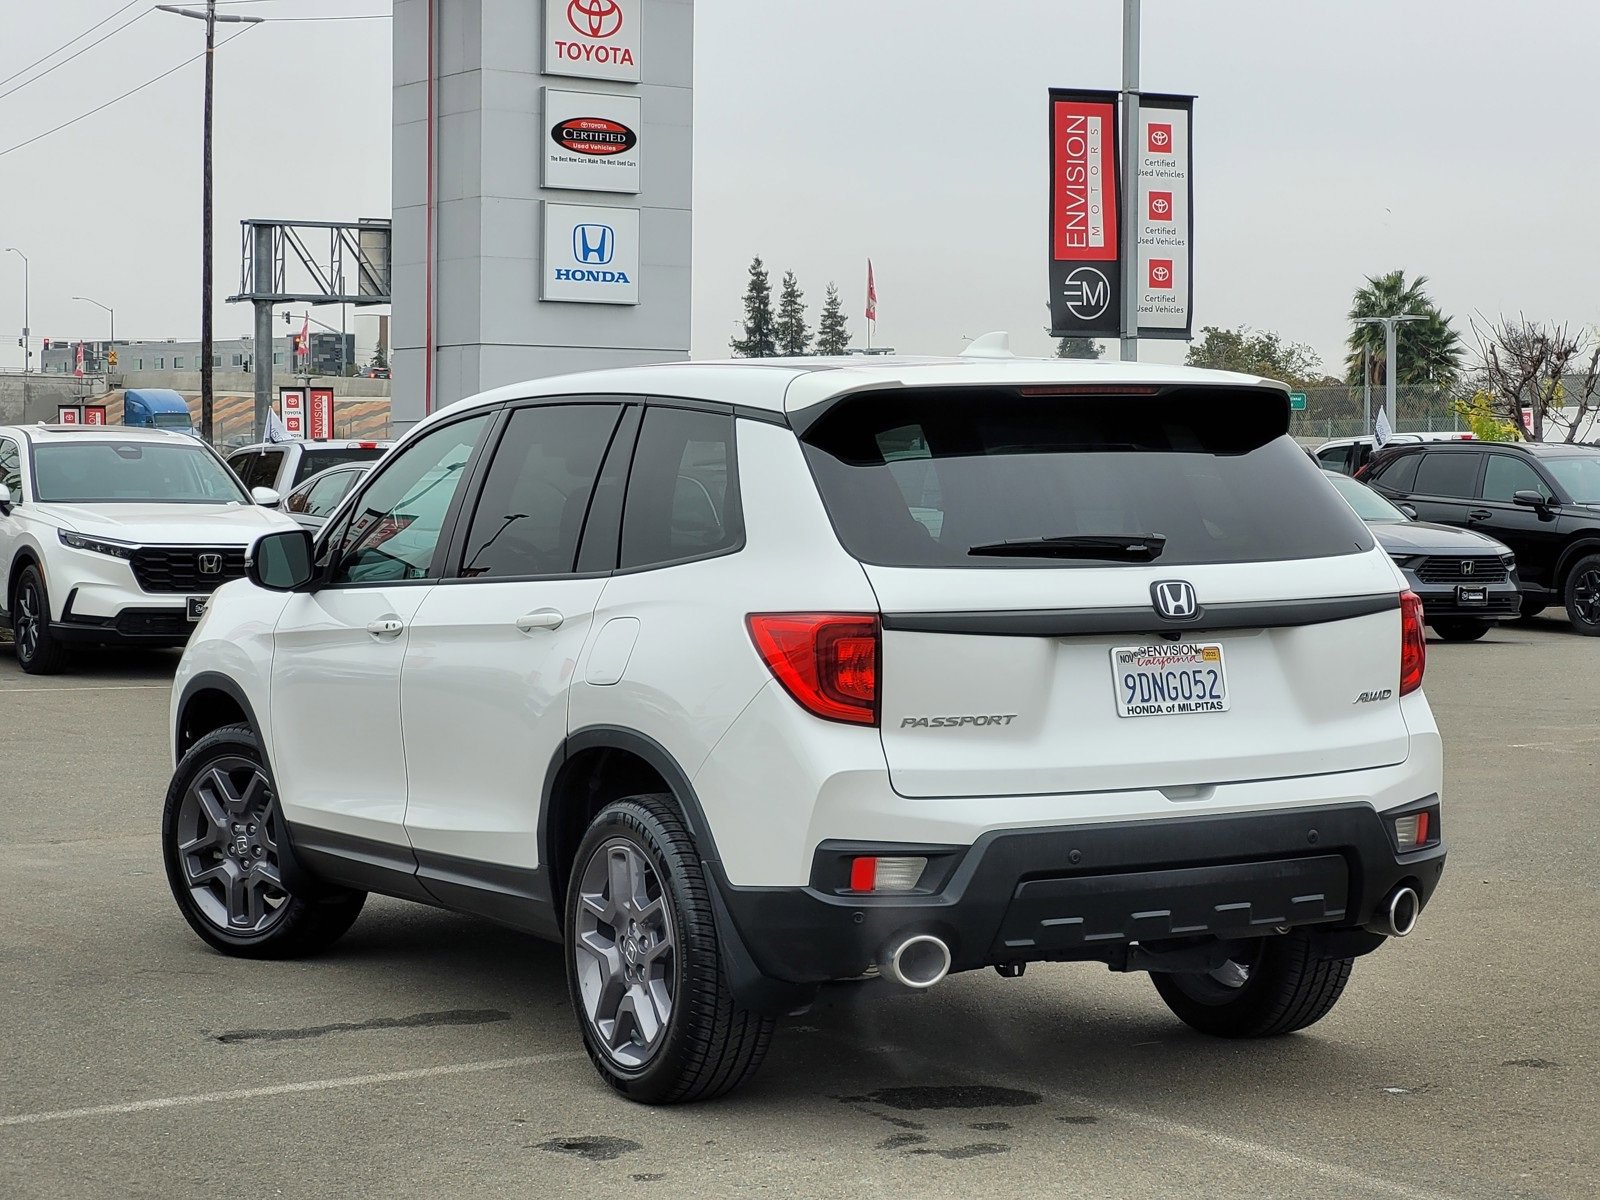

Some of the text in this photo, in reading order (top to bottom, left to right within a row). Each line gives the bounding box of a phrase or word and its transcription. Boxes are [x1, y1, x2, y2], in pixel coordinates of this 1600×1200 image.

[555, 41, 634, 65] TOYOTA
[1144, 158, 1176, 167] Certified
[1066, 115, 1087, 247] ENVISION
[1155, 170, 1184, 178] Vehicles
[1090, 128, 1101, 236] MOTORS
[1145, 226, 1176, 235] Certified
[1156, 238, 1185, 246] Vehicles
[555, 268, 630, 284] HONDA
[1144, 294, 1176, 303] Certified
[1155, 306, 1184, 314] Vehicles
[314, 395, 322, 438] ENVISION
[1148, 644, 1198, 657] ENVISION
[1120, 654, 1134, 664] NOV
[1124, 669, 1221, 704] 9DNG052
[1352, 690, 1392, 704] AWD
[1127, 701, 1223, 715] HONDA of MILPITAS
[900, 714, 1018, 728] PASSPORT
